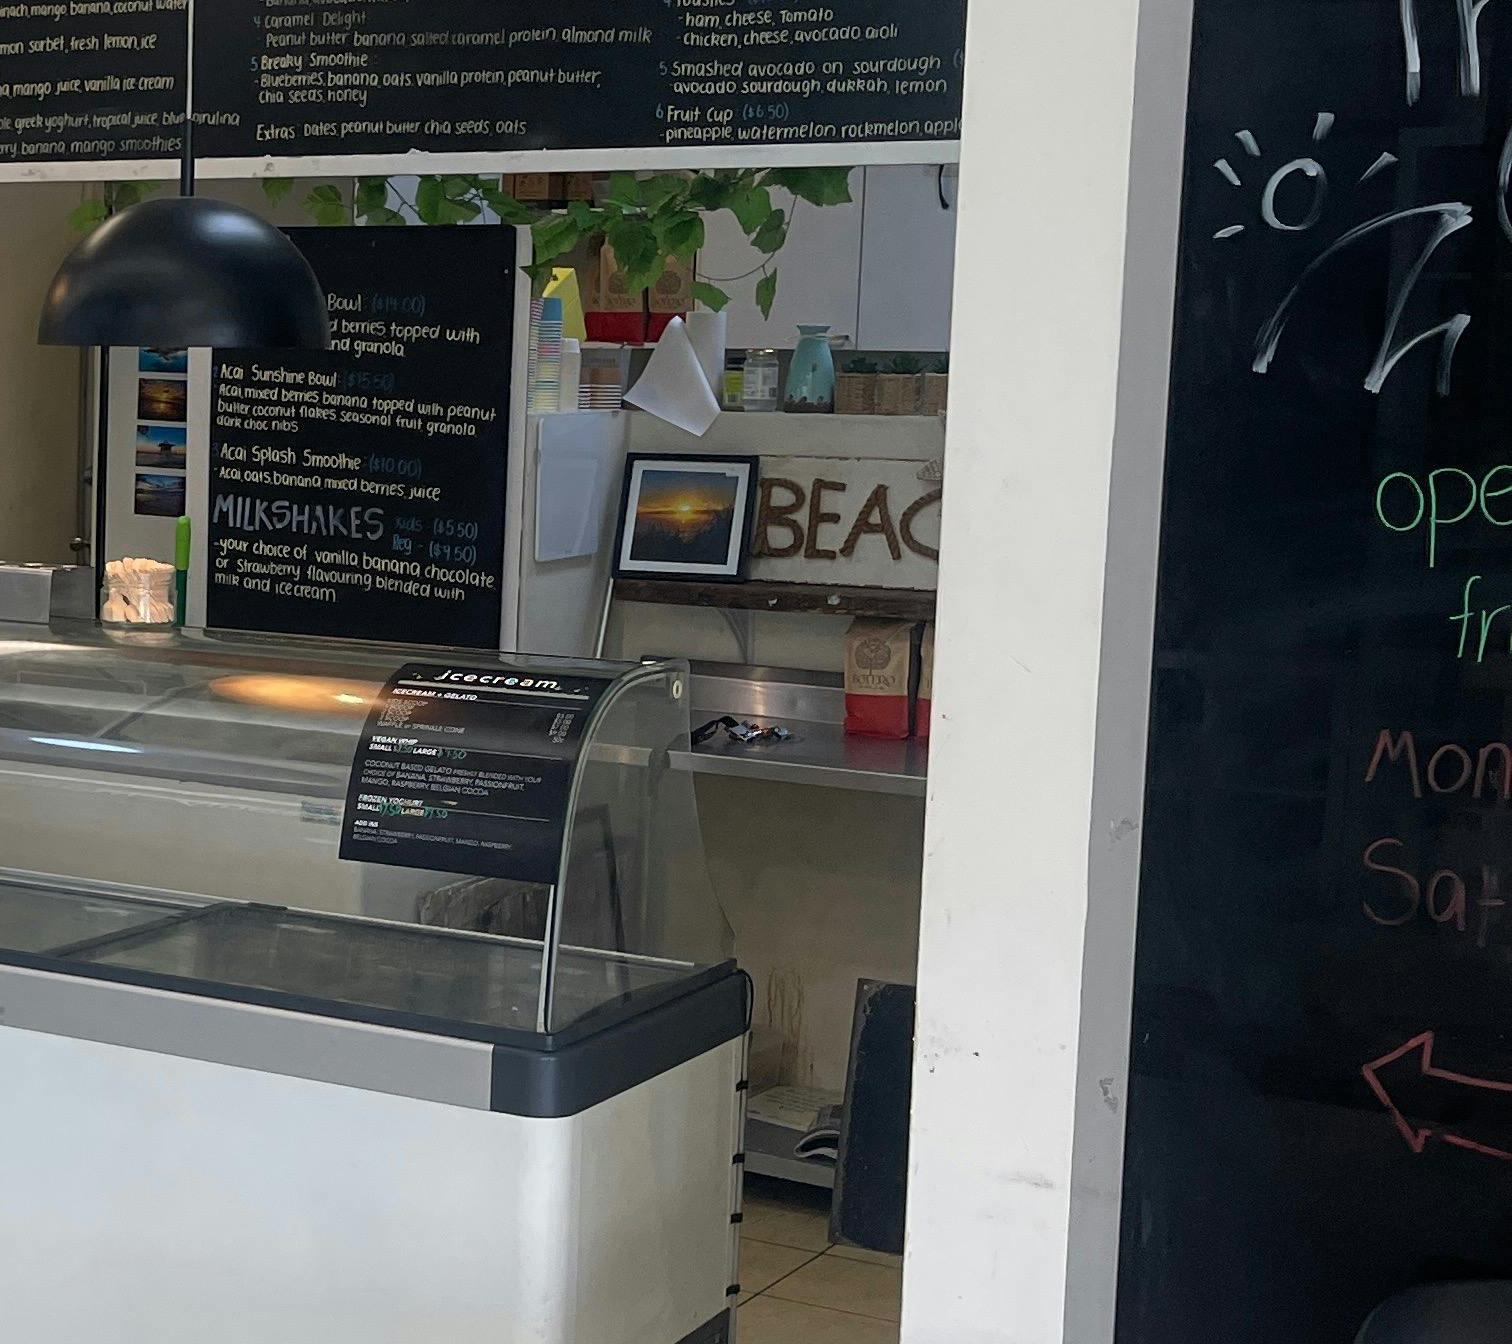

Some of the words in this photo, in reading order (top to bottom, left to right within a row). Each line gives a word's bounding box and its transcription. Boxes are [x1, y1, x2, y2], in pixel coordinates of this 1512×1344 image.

[322, 11, 368, 30] Delight
[779, 7, 834, 23] Tomato
[265, 31, 307, 48] Peanut
[309, 30, 347, 47] butter
[451, 28, 506, 47] caramel
[561, 25, 615, 44] almond
[618, 25, 653, 44] milk
[865, 23, 899, 40] aioli
[70, 36, 99, 51] fresh
[250, 57, 259, 72] 5
[261, 54, 303, 72] Breaky
[308, 52, 369, 68] Smoothie
[672, 60, 742, 77] Smashed
[748, 60, 815, 77] avocado
[822, 61, 843, 75] on
[852, 57, 941, 78] sourdough
[13, 82, 52, 101] mango
[84, 75, 121, 92] vanilla
[138, 76, 174, 91] cream
[416, 71, 459, 87] vanilla
[508, 68, 555, 87] peanut
[896, 78, 947, 94] lemon
[258, 88, 284, 104] chia
[327, 88, 368, 108] honey
[656, 104, 664, 119] 6
[667, 105, 701, 122] Fruit
[706, 107, 734, 124] Cup
[256, 123, 296, 141] Extras
[341, 121, 383, 139] peanut
[424, 119, 451, 135] chia
[495, 119, 527, 135] oats
[737, 124, 835, 140] watermelon
[924, 119, 961, 136] appl
[70, 138, 116, 157] mango
[120, 135, 183, 152] smoothies
[328, 292, 362, 312] Bowl
[390, 322, 440, 339] topped
[445, 327, 481, 344] with
[354, 338, 405, 358] granola
[220, 364, 244, 379] Acai
[251, 364, 305, 385] Sunshine
[308, 370, 337, 387] Bowl
[251, 404, 296, 417] coconut
[339, 408, 391, 426] seasonal
[322, 391, 368, 409] banana
[372, 396, 414, 414] topped
[417, 401, 444, 416] with
[448, 403, 496, 422] peanut
[216, 415, 240, 429] dark
[243, 417, 268, 431] choc
[271, 417, 298, 433] nibs
[220, 442, 247, 462] Acai
[251, 445, 297, 465] Splash
[302, 448, 361, 471] Smoothie
[409, 484, 441, 502] juice
[212, 493, 384, 541] MILKSHAKES
[756, 478, 942, 562] BEAC
[252, 540, 290, 558] choice
[294, 544, 308, 561] of
[424, 563, 495, 589] chocolate
[214, 571, 240, 587] milk
[243, 576, 270, 593] and
[215, 557, 229, 569] or
[306, 564, 373, 592] flavouring
[375, 574, 429, 598] blended
[434, 585, 465, 601] with
[1449, 575, 1512, 663] fr
[1364, 729, 1512, 800] Mon
